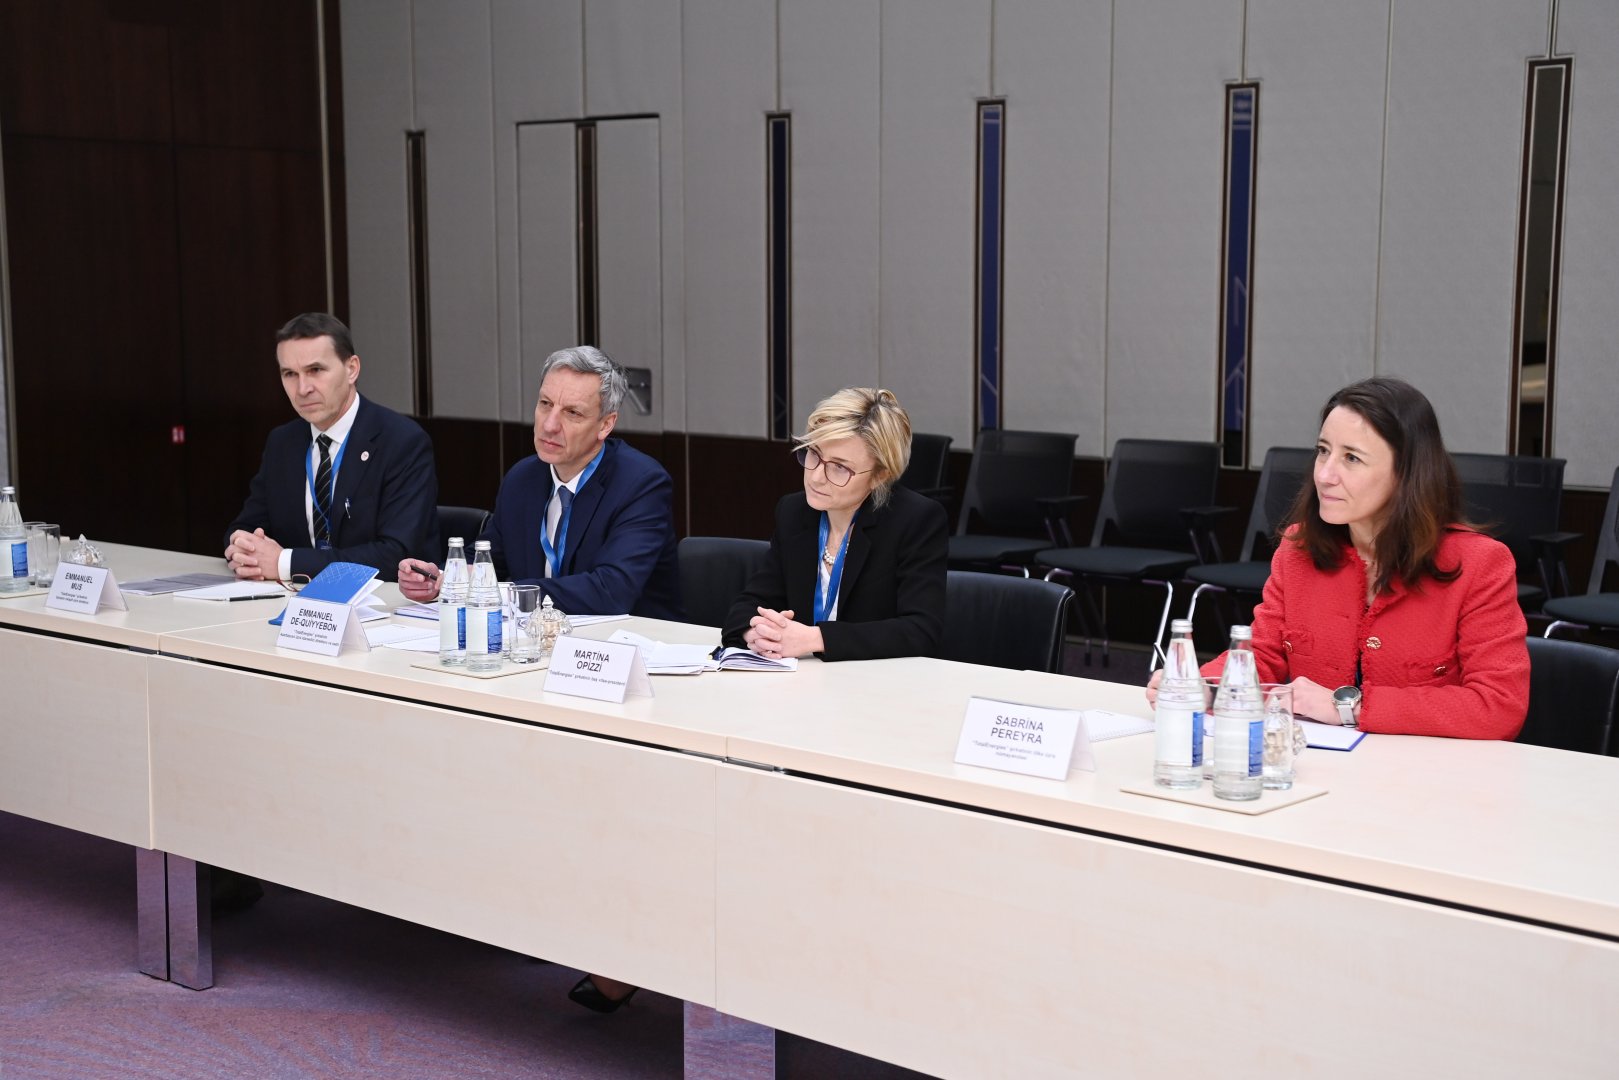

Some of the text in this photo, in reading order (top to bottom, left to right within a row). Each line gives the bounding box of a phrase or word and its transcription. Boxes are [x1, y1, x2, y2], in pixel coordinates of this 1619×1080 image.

[65, 572, 93, 584] EMMANUEL
[298, 608, 333, 621] EMMANUEL
[574, 649, 610, 663] MARTİNA
[576, 660, 603, 672] OPİZZİ
[995, 715, 1044, 732] SABRİNA
[990, 727, 1043, 744] PEREYRA
